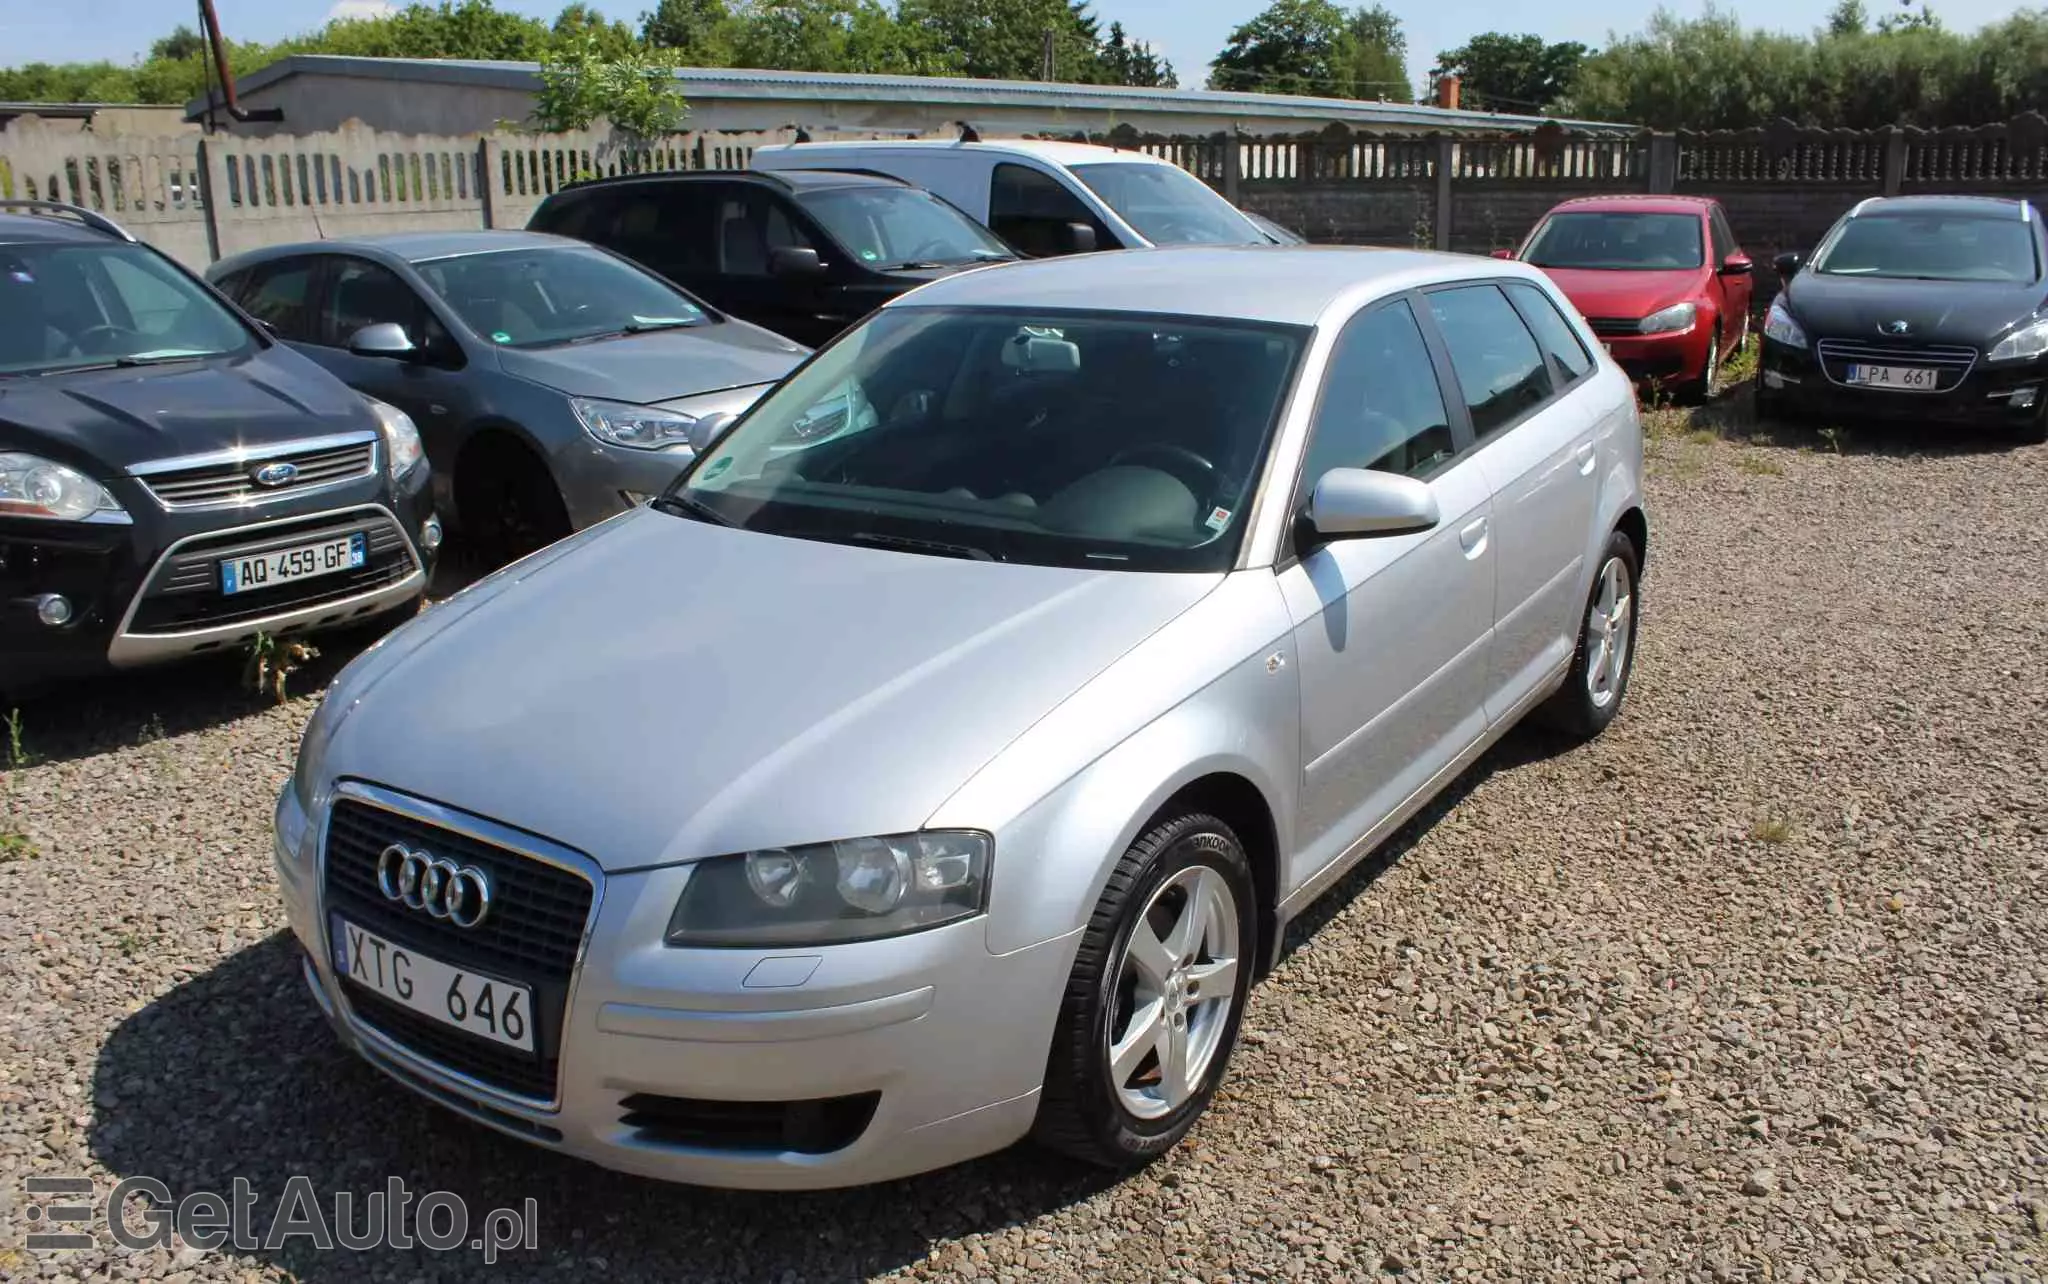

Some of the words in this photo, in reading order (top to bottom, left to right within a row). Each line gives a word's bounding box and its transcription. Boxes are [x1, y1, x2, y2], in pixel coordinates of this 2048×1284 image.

[1857, 366, 1890, 383] LPA
[1903, 369, 1933, 385] 661
[350, 927, 413, 1000] XTG
[447, 973, 524, 1041] 646
